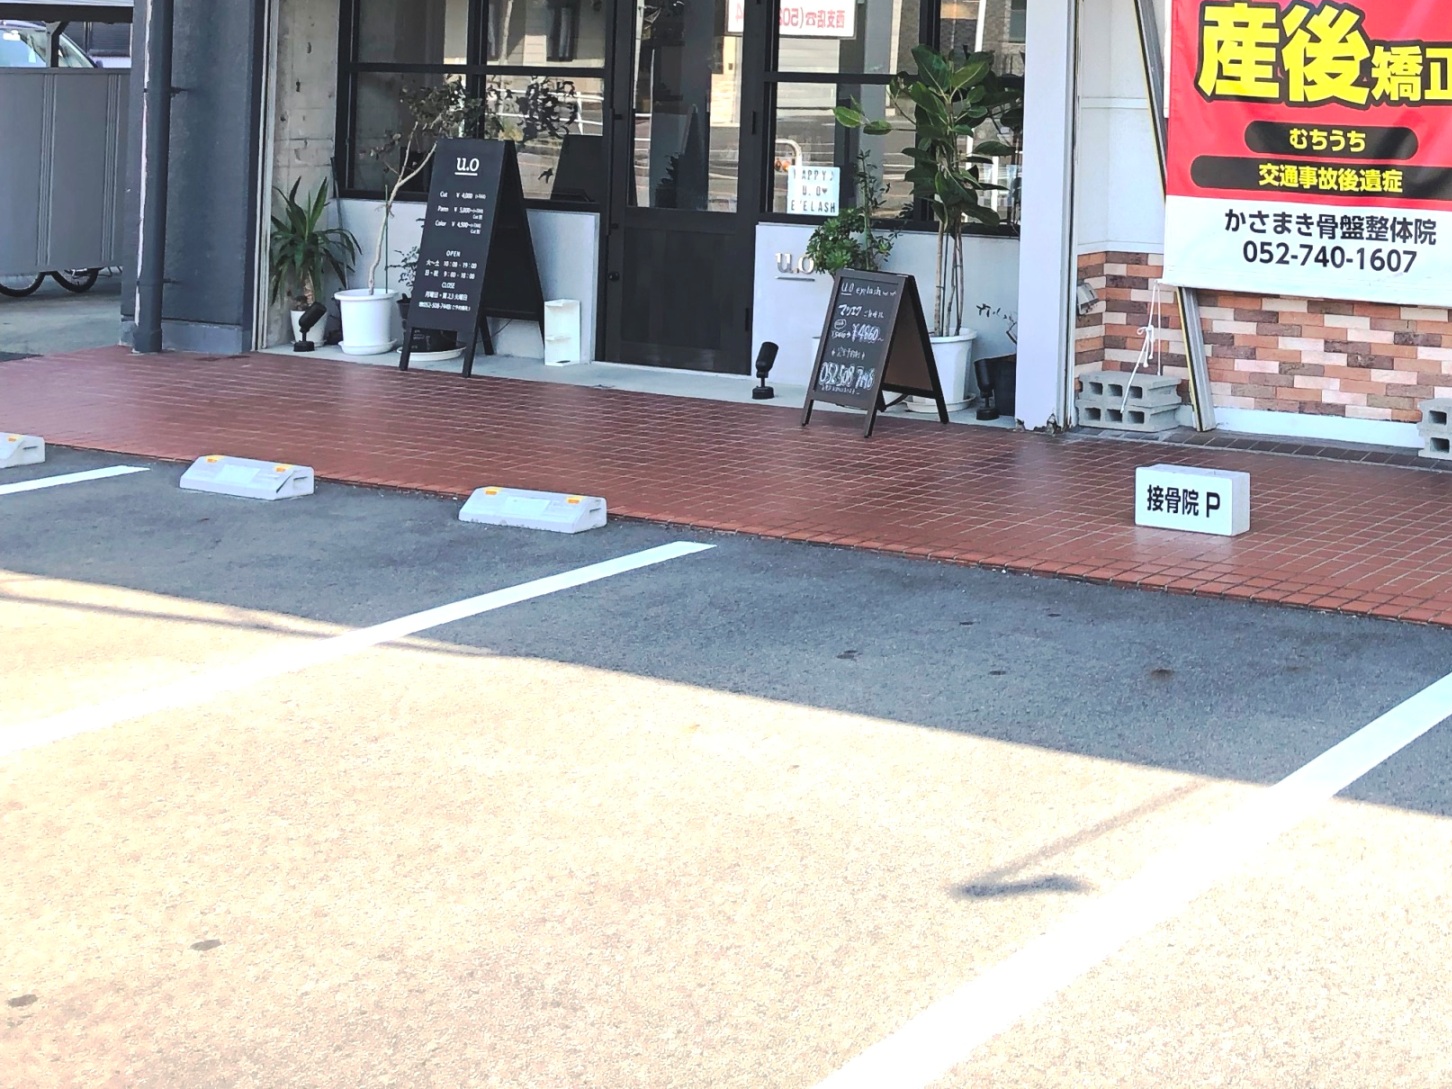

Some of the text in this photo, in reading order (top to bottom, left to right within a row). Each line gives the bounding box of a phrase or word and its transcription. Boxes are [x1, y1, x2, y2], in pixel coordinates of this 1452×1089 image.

[1289, 128, 1367, 152] むちうち
[1258, 163, 1403, 193] 交通事故後遺症
[791, 199, 836, 213] EELASH
[1224, 209, 1437, 245] かさまき骨盤整体院
[1243, 242, 1417, 274] 052-740-1607
[1147, 484, 1221, 518] 接骨院 P
